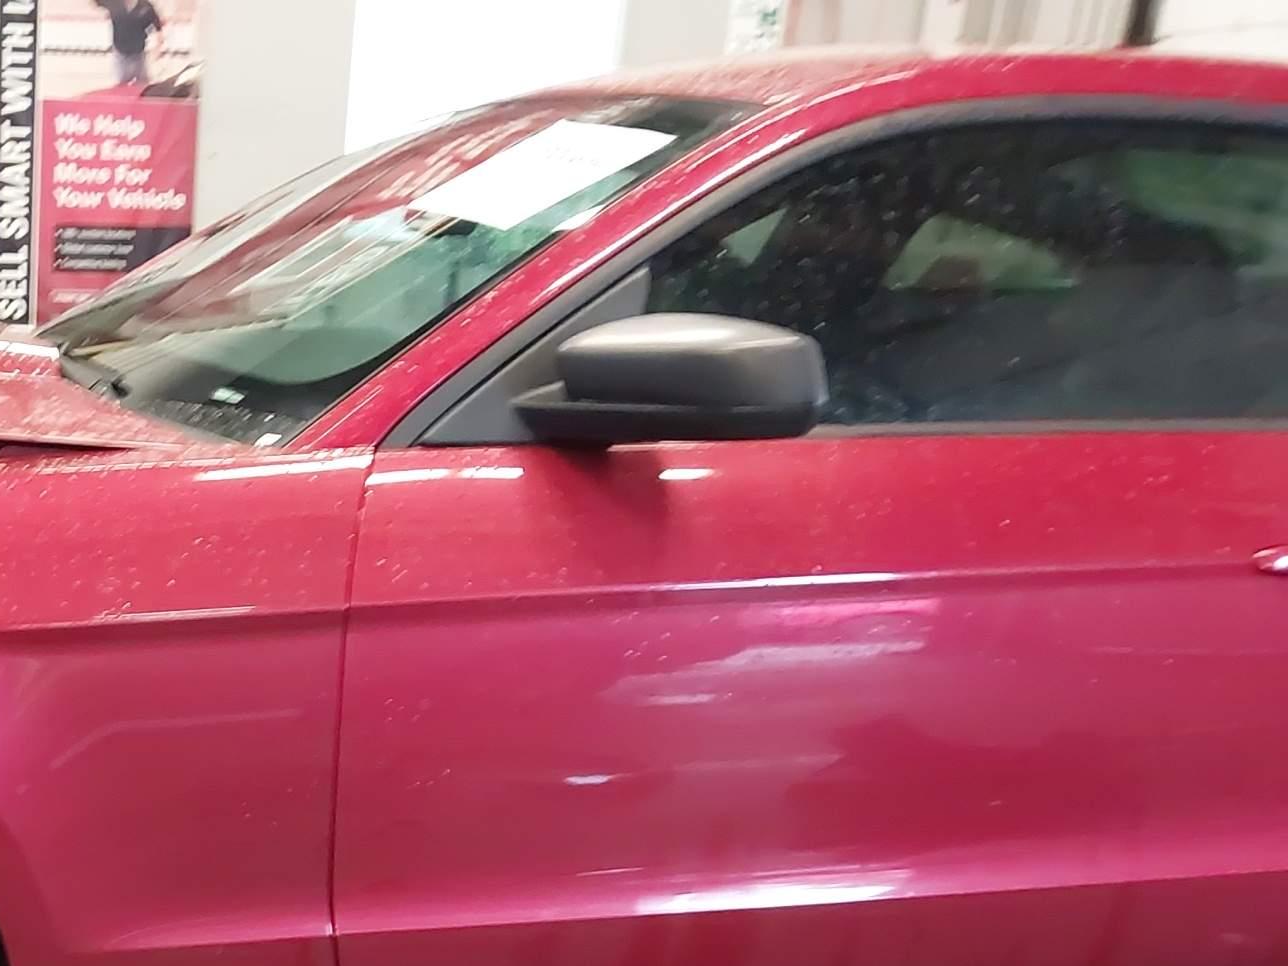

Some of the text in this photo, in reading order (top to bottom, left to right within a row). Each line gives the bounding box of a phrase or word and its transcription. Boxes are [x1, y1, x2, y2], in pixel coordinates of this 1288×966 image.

[1, 22, 34, 115] WITH
[54, 113, 145, 140] We Help
[54, 138, 152, 161] You Earn
[53, 163, 152, 185] More For
[53, 187, 187, 210] Your Vehicle
